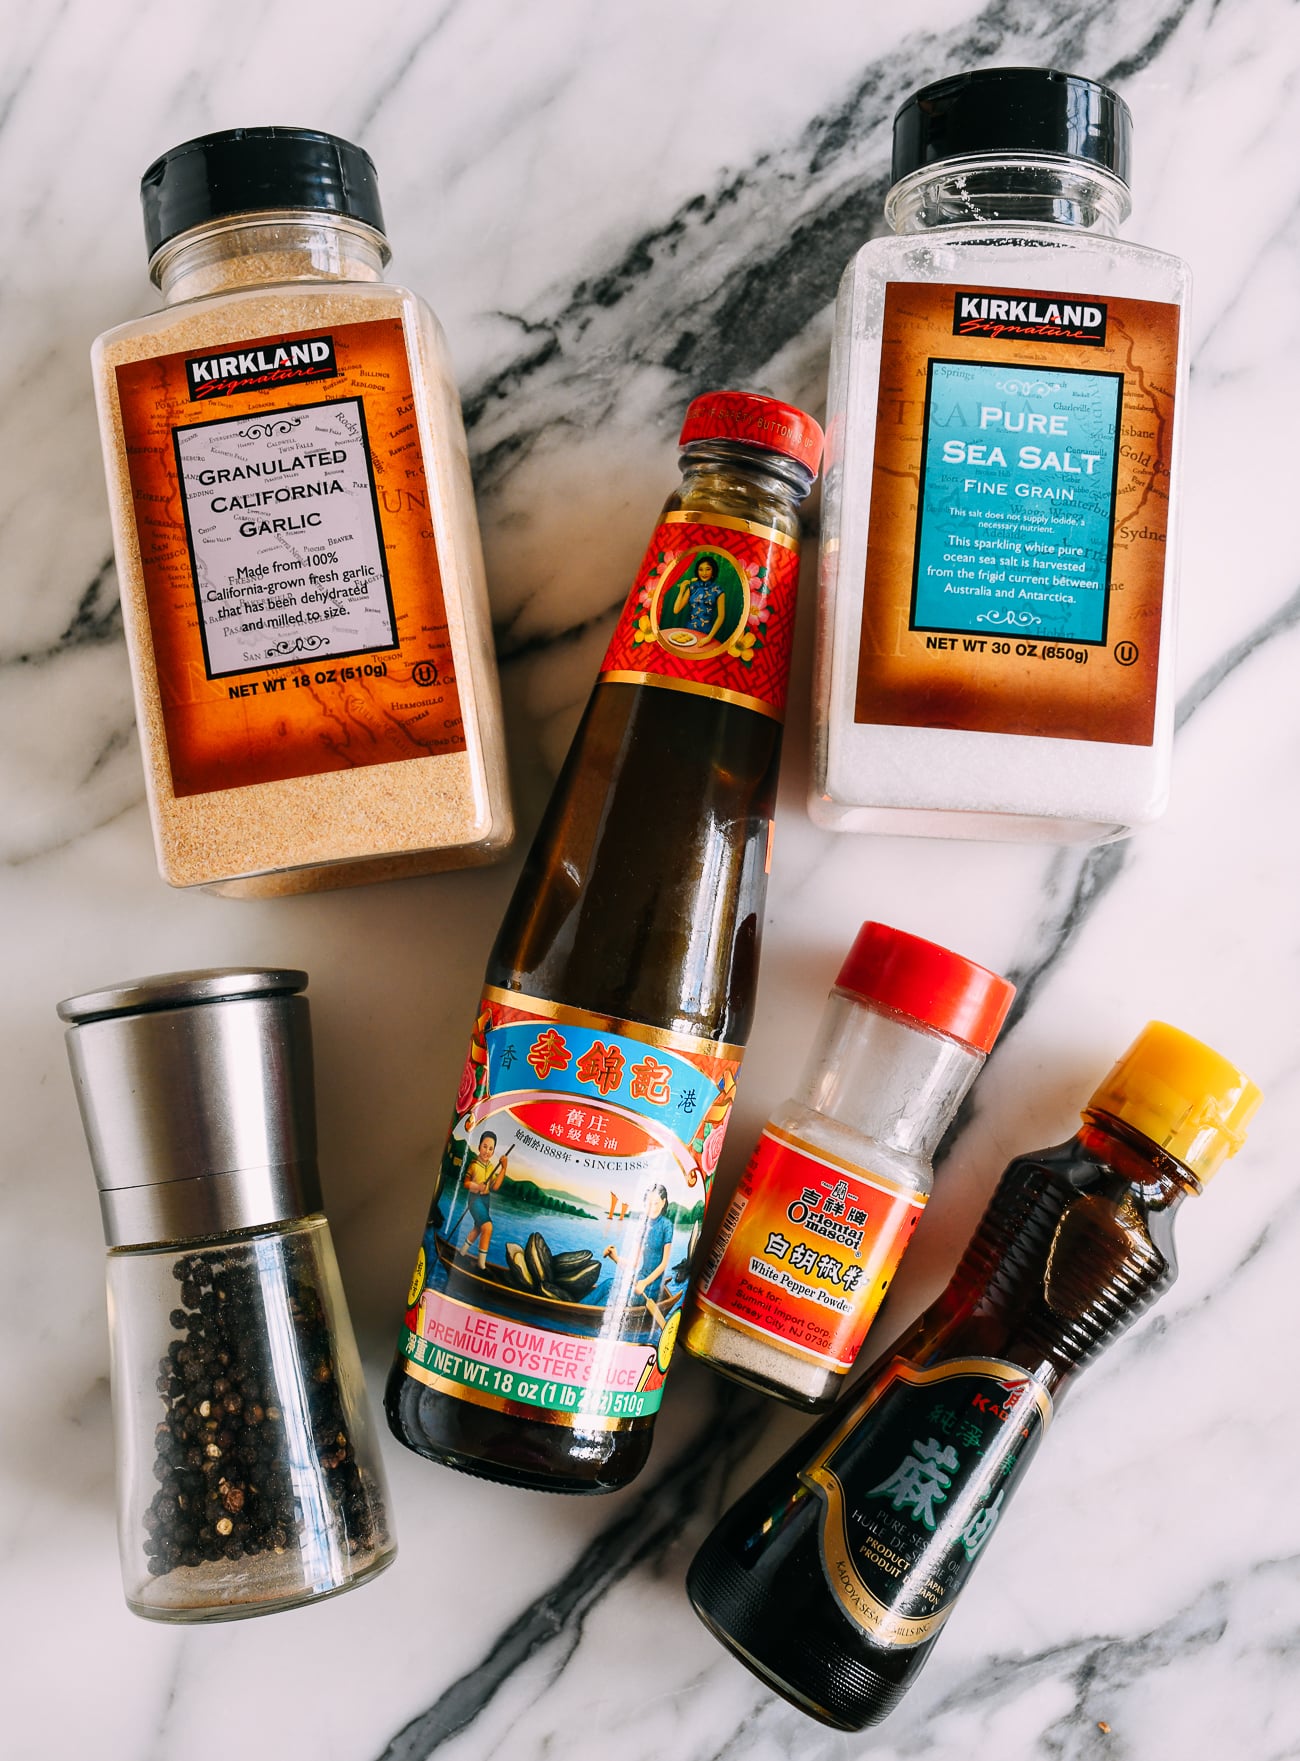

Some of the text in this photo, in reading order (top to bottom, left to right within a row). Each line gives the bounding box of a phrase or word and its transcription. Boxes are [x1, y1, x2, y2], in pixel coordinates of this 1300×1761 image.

[959, 316, 1101, 339] Signature
[961, 297, 1102, 327] KIRKLAND
[191, 340, 331, 384] KIRKLAND
[359, 369, 390, 379] BILLINGS
[194, 365, 334, 399] Signature
[335, 412, 360, 437] Rocky
[718, 408, 753, 425] SAFETY
[757, 416, 793, 438] BUTTON
[804, 437, 815, 449] UP
[980, 405, 1069, 437] PURE
[198, 449, 348, 486] GRANULATED
[942, 439, 1101, 475] SEA SALT
[1120, 444, 1152, 467] Gold
[210, 479, 344, 513] CALIFORNIA
[964, 479, 1009, 496] FINE
[1014, 482, 1075, 501] GRAIN
[239, 512, 323, 538] GARLIC
[949, 507, 966, 517] This
[968, 508, 982, 518] salt
[984, 509, 1005, 520] does
[1006, 511, 1021, 521] not
[1023, 514, 1049, 525] supply
[978, 521, 1055, 534] necessary nutrient.
[327, 534, 354, 546] BEAVER
[948, 534, 1084, 557] This sparkling white pure
[236, 551, 339, 580] Made from 100%
[927, 564, 1099, 590] from the frigid current between
[943, 552, 1086, 573] ocean sea salt is harvested
[206, 577, 306, 602] California-grown
[309, 569, 339, 585] fresh
[342, 565, 376, 582] garlic
[943, 582, 1077, 604] Australia and Antarctica.
[218, 583, 369, 619] that has been dehydrated
[241, 618, 264, 632] and
[267, 610, 303, 628] milled
[306, 611, 320, 622] to
[323, 606, 351, 619] size.
[371, 652, 403, 663] TUCSON
[926, 636, 1089, 665] NET WT 30 OZ (850g)
[228, 682, 259, 700] NET
[262, 677, 287, 693] WT
[292, 674, 311, 688] 18
[314, 669, 337, 684] OZ
[340, 661, 388, 683] (510g)
[390, 696, 445, 711] HERMOSILLO
[499, 1028, 697, 1114] 香 李錦記 港
[549, 1122, 619, 1151] 特級蠔油
[787, 1199, 865, 1242] Oriental
[801, 1187, 868, 1227] 吉祥牌
[805, 1219, 861, 1251] mascot
[740, 1278, 782, 1305] Pack for:
[750, 1256, 854, 1314] White Pepper Powder
[730, 1298, 763, 1324] Jersey
[764, 1312, 787, 1333] City,
[788, 1324, 804, 1339] NJ
[735, 1289, 831, 1340] Summit Import Corp.
[464, 1315, 499, 1340] LEE
[501, 1326, 543, 1354] KUM
[427, 1319, 637, 1387] PREMIUM OYSTER SUCE
[464, 1361, 489, 1387] WT.
[493, 1370, 514, 1393] 18
[517, 1381, 538, 1401] oz
[540, 1381, 557, 1405] (1
[561, 1385, 576, 1407] lb
[851, 1508, 887, 1538] HUILE
[889, 1535, 907, 1553] DE
[877, 1509, 908, 1537] PURE
[860, 1544, 902, 1579] PRODUIT
[865, 1535, 911, 1572] PRODUCT
[835, 1560, 861, 1607] KADOYA
